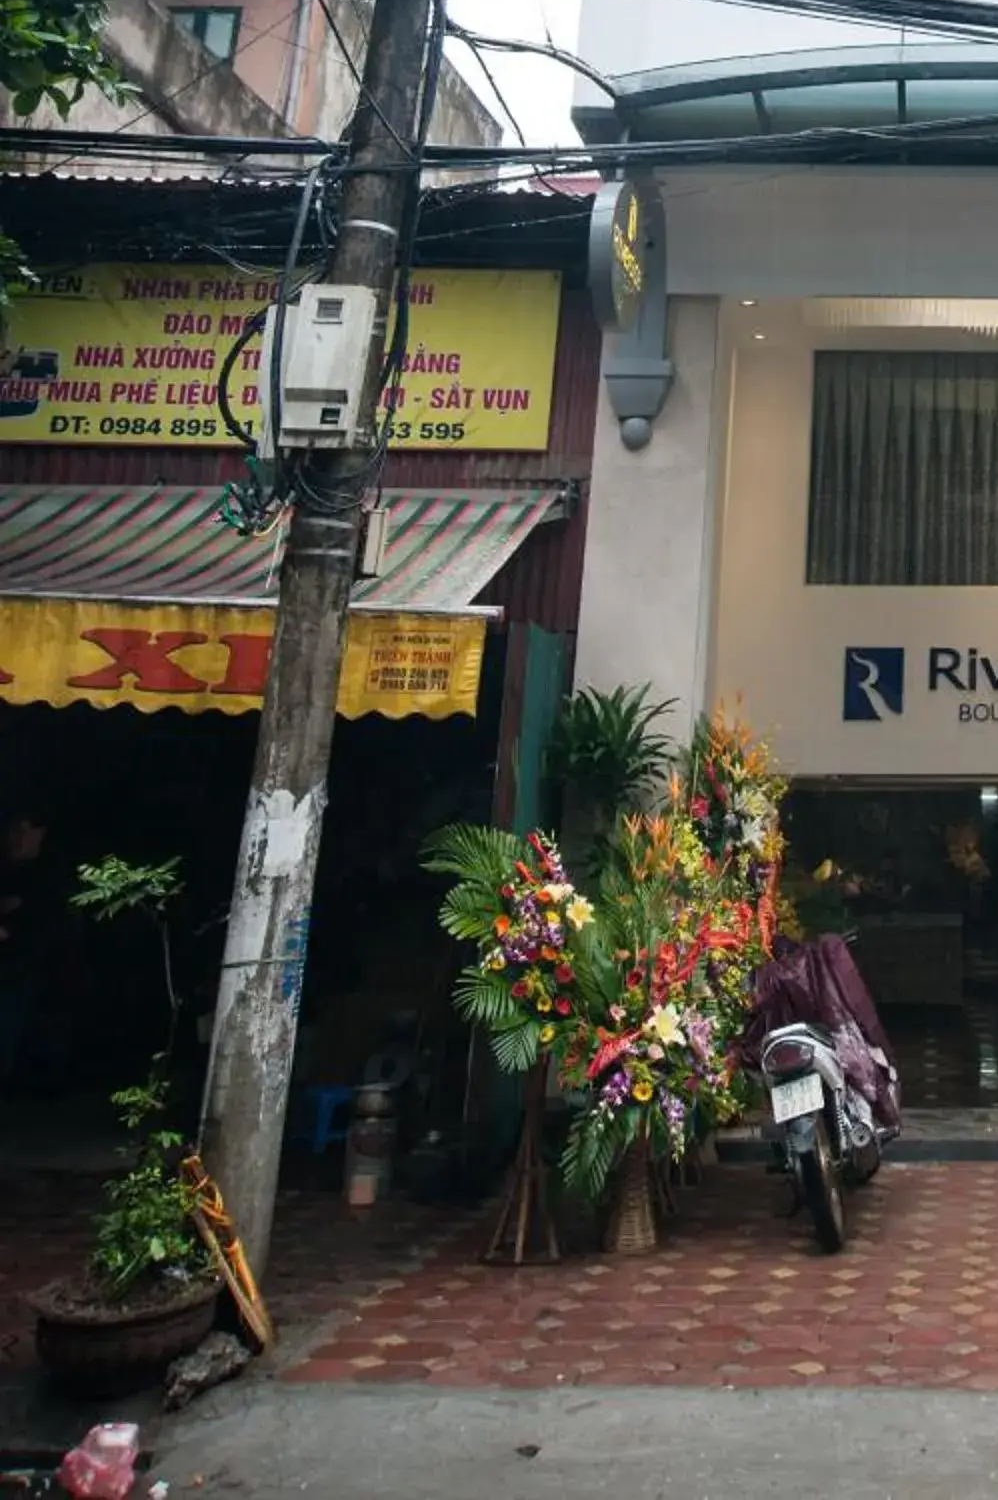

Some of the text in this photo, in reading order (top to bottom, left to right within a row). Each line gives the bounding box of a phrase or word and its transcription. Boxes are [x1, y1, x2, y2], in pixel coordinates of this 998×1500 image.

[48, 381, 101, 402] MUA
[100, 417, 161, 436] 0984
[171, 419, 217, 437] 895
[420, 421, 465, 440] 595
